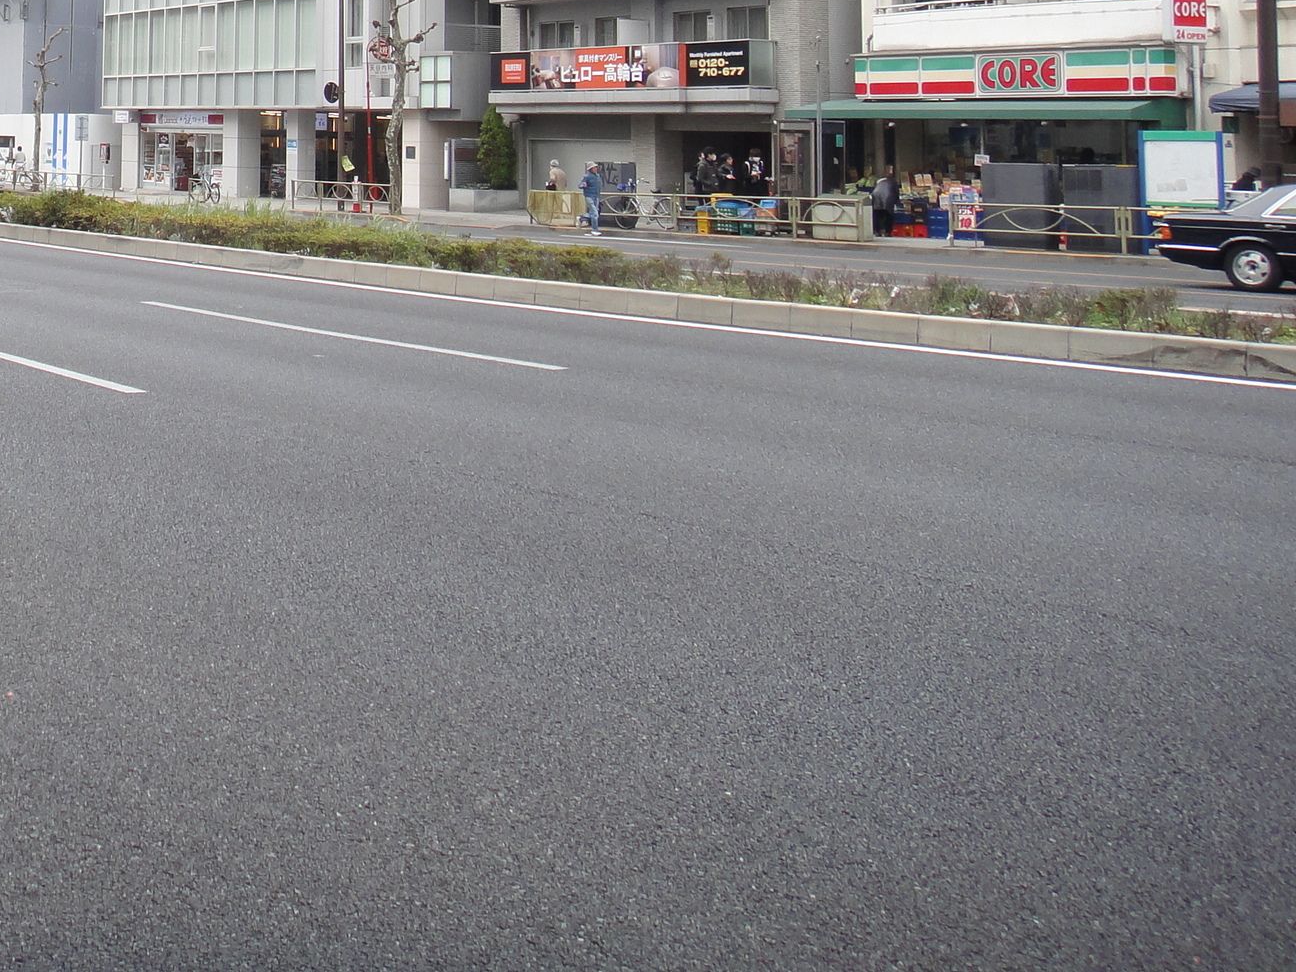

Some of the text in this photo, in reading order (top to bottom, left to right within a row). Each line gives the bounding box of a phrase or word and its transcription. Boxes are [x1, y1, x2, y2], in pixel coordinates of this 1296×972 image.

[1174, 1, 1206, 17] CORE
[1176, 29, 1185, 39] 24
[560, 63, 644, 83] ビュロー高輪台
[698, 67, 745, 77] 710-677
[980, 56, 1057, 89] CORE
